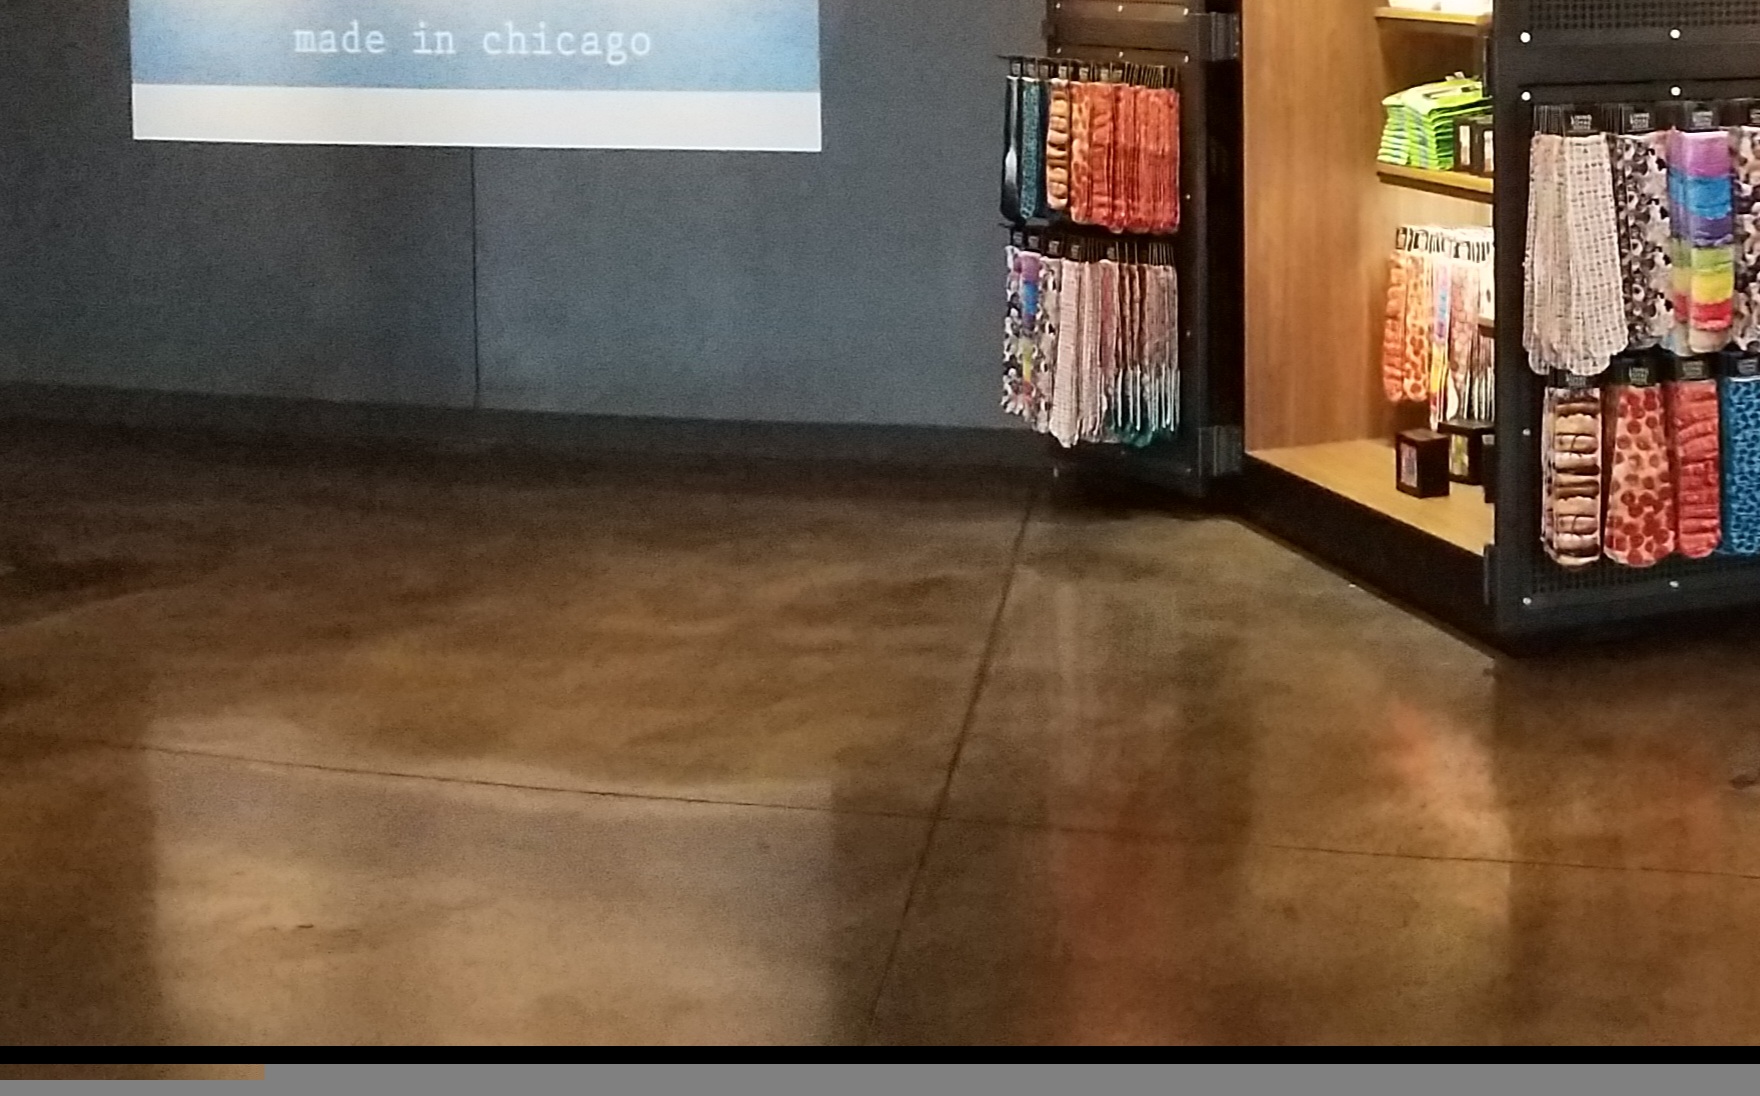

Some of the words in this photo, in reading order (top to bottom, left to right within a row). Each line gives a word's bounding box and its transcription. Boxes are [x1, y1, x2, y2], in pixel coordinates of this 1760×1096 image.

[293, 19, 387, 55] made
[412, 20, 456, 55] in
[481, 20, 653, 66] chicago
